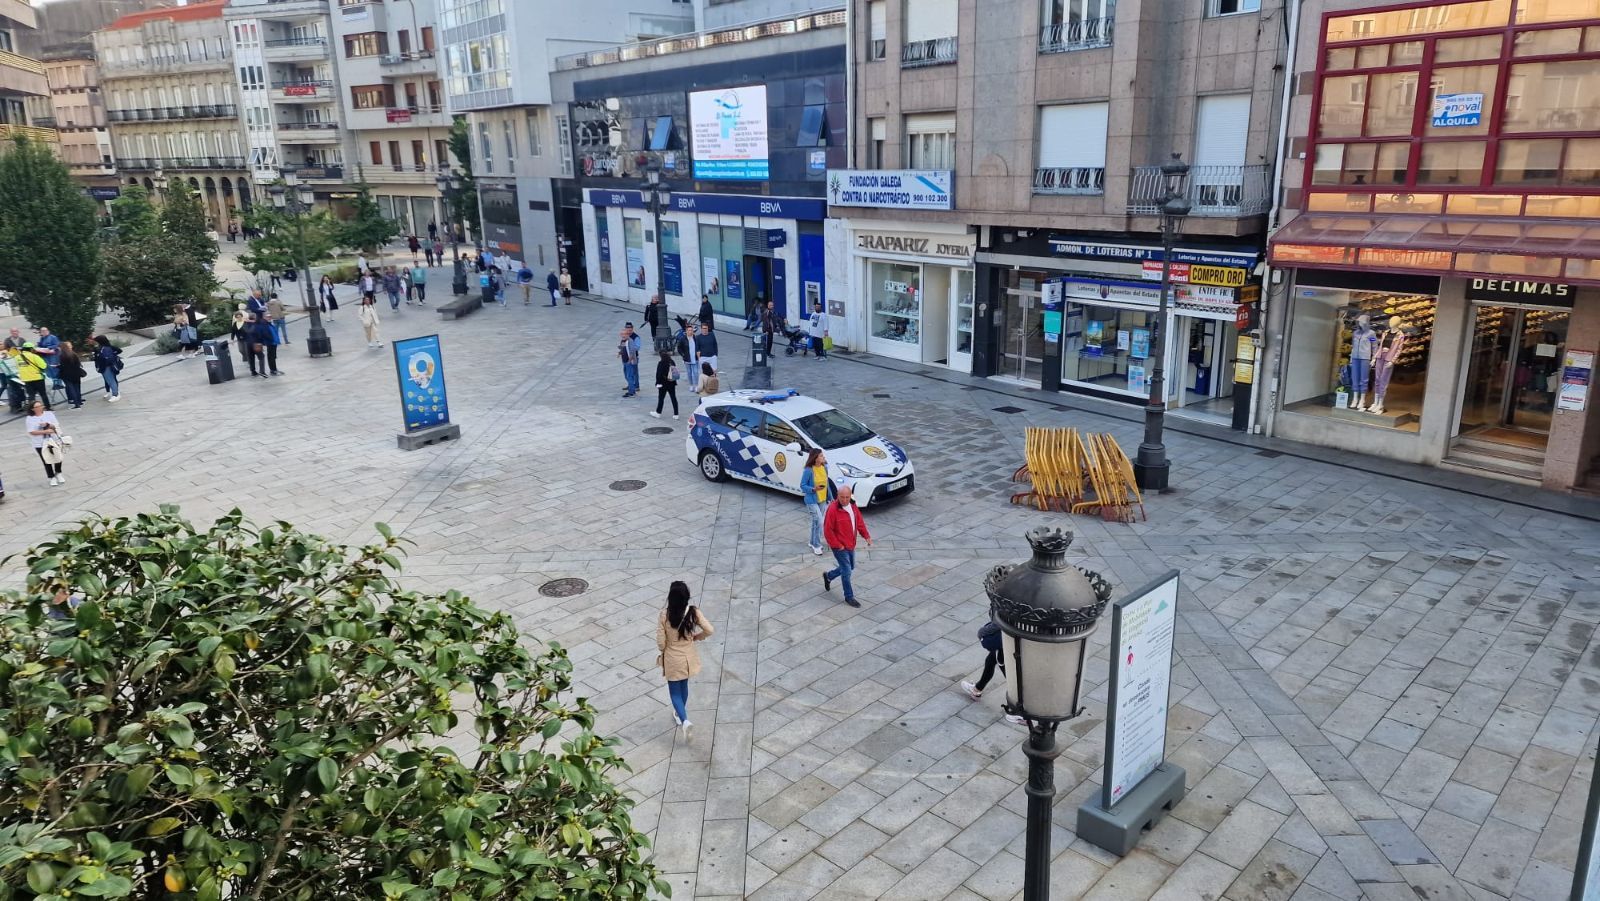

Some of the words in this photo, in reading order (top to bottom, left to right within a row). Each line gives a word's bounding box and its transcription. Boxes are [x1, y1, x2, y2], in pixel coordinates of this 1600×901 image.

[1433, 117, 1478, 126] ALQUILA
[849, 173, 879, 188] FUNDACIÓN
[880, 176, 902, 188] GALEGA
[611, 194, 627, 204] BBVA
[678, 198, 696, 208] BBVA
[841, 191, 863, 203] CONTRA
[863, 192, 867, 203] O
[869, 189, 910, 205] NARCOTRÁFICO
[913, 194, 924, 202] 900
[760, 202, 782, 213] BBVA
[1085, 246, 1095, 255] DE
[1147, 250, 1152, 259] 1
[1192, 267, 1225, 283] COMPRO
[1226, 269, 1243, 285] ORO
[1472, 278, 1569, 296] DECIMAS
